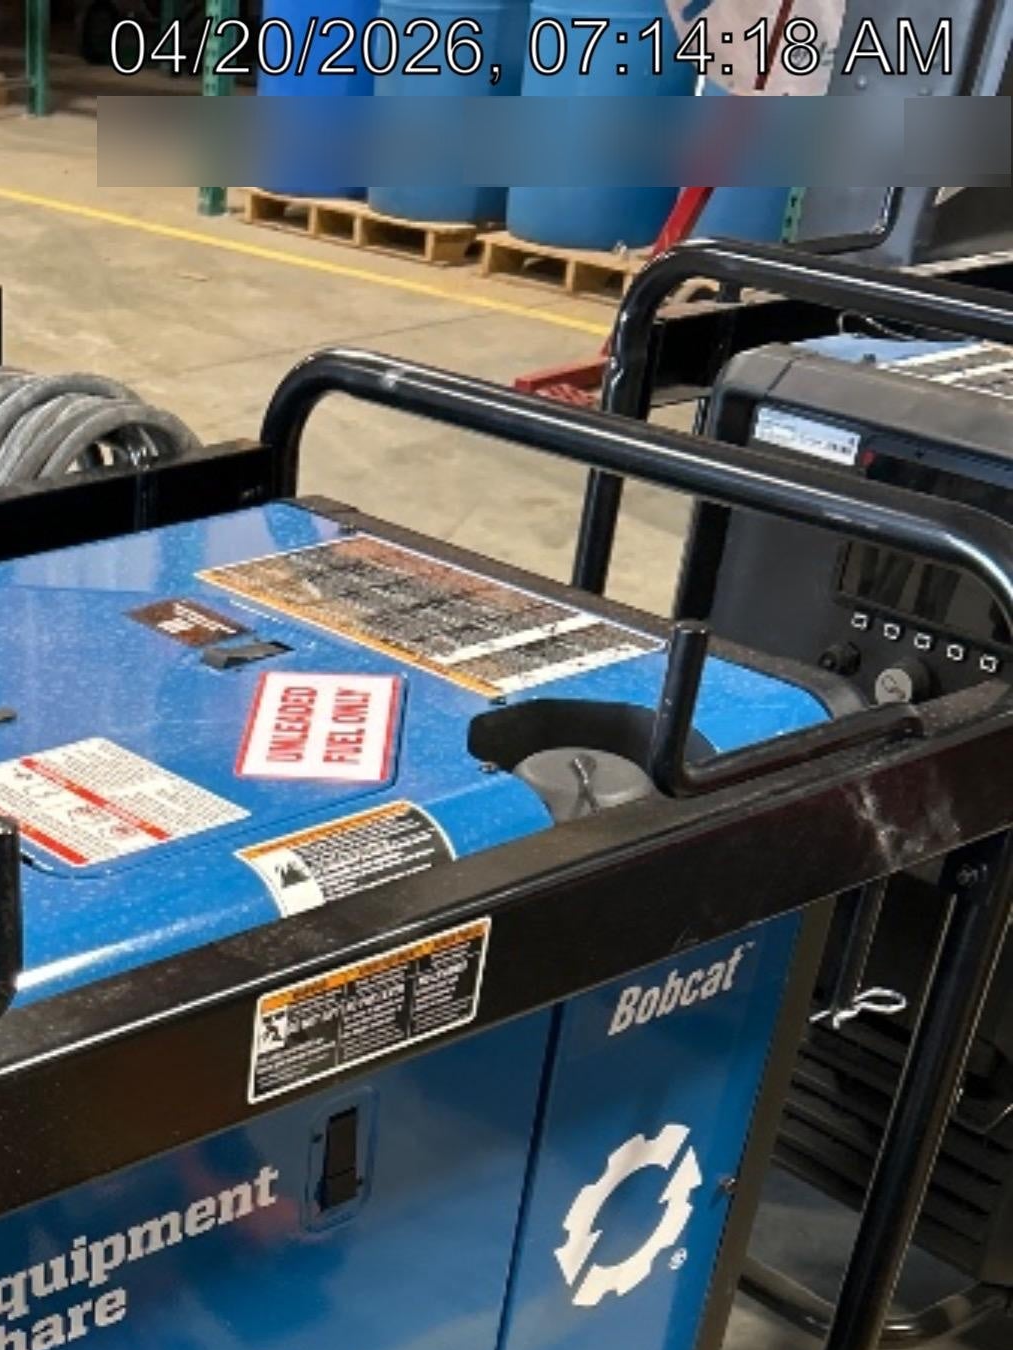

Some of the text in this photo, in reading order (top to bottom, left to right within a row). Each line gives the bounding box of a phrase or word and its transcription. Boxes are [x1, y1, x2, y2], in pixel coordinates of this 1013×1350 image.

[266, 685, 318, 763] UNLEADED
[322, 686, 372, 765] FUEL ONLY
[607, 944, 745, 1036] Bobcat
